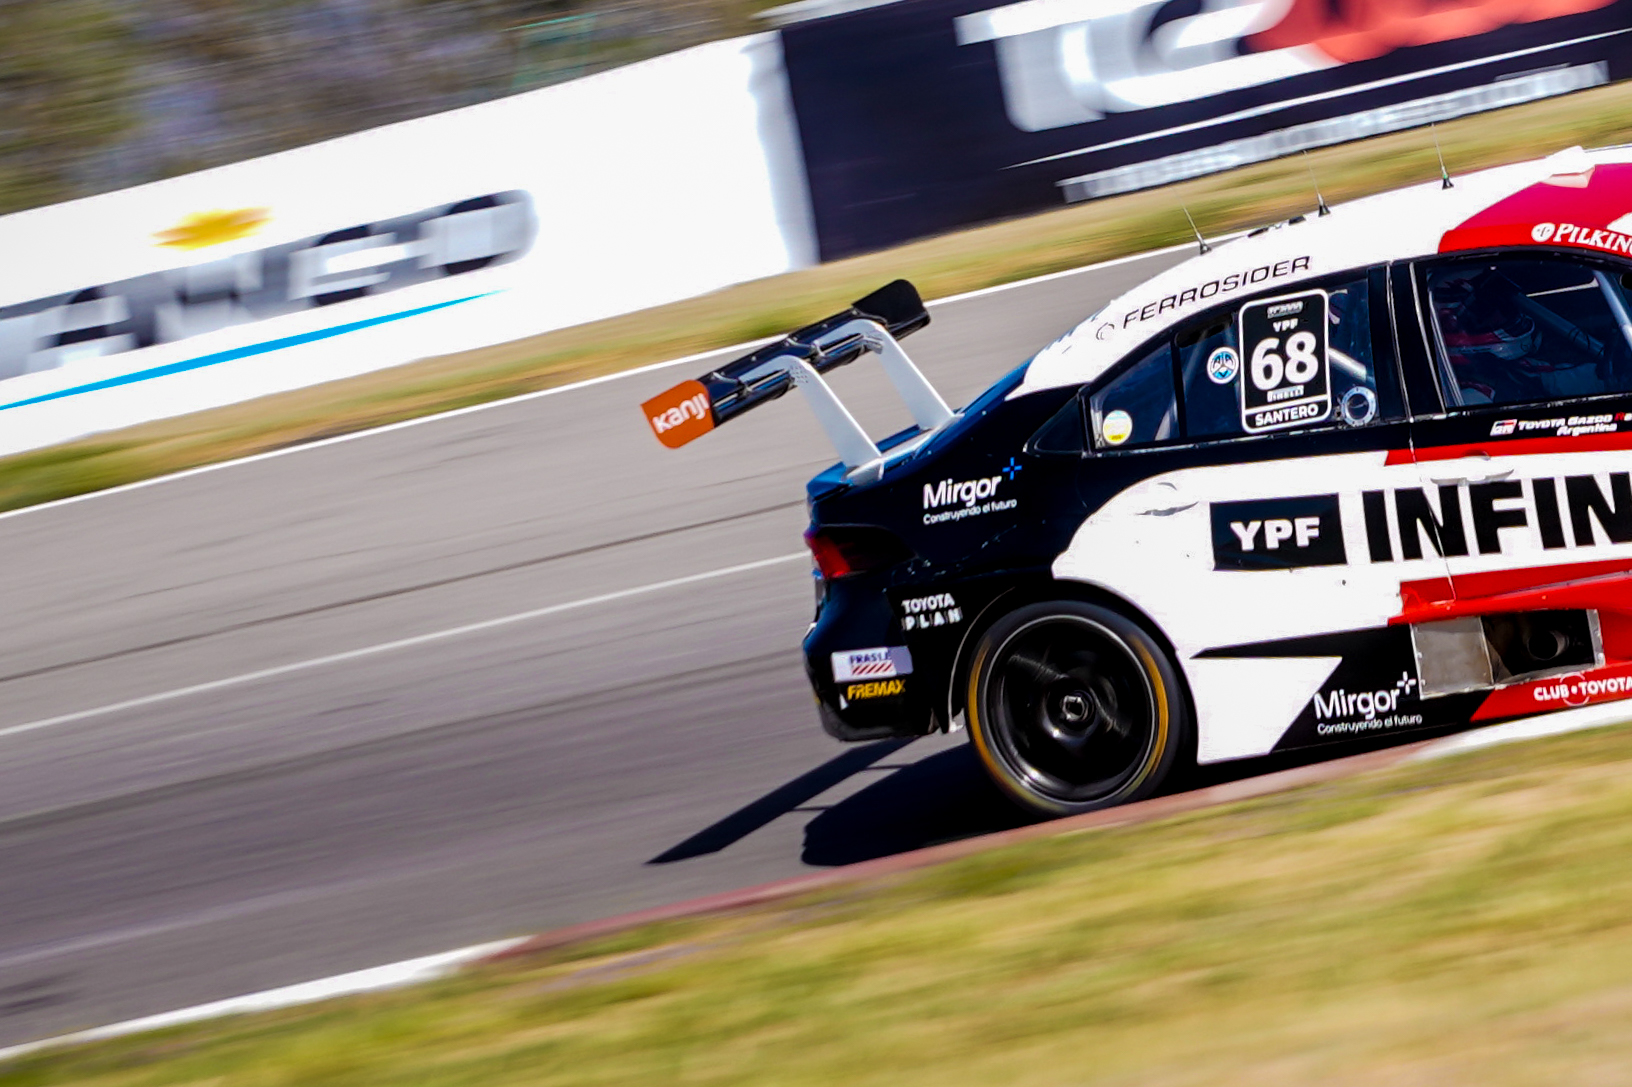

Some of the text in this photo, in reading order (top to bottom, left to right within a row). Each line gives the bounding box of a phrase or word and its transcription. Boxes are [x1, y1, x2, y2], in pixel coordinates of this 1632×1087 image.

[1123, 256, 1311, 329] FERROSIDER
[1273, 318, 1298, 332] YPF
[1250, 331, 1319, 391] 68
[652, 393, 710, 433] kanji
[1255, 403, 1319, 426] SANTERO
[1518, 418, 1565, 431] TOYOTA
[1557, 423, 1617, 437] Argentina
[923, 475, 1002, 509] Mirgor
[923, 505, 981, 525] Construyendo
[1230, 517, 1320, 552] YPF
[901, 593, 955, 614] TOYOTA
[847, 679, 906, 701] FREMAX
[1534, 683, 1570, 701] CLUB
[1313, 688, 1401, 721] Mirgor
[1317, 714, 1423, 736] Construyendo el futuro
